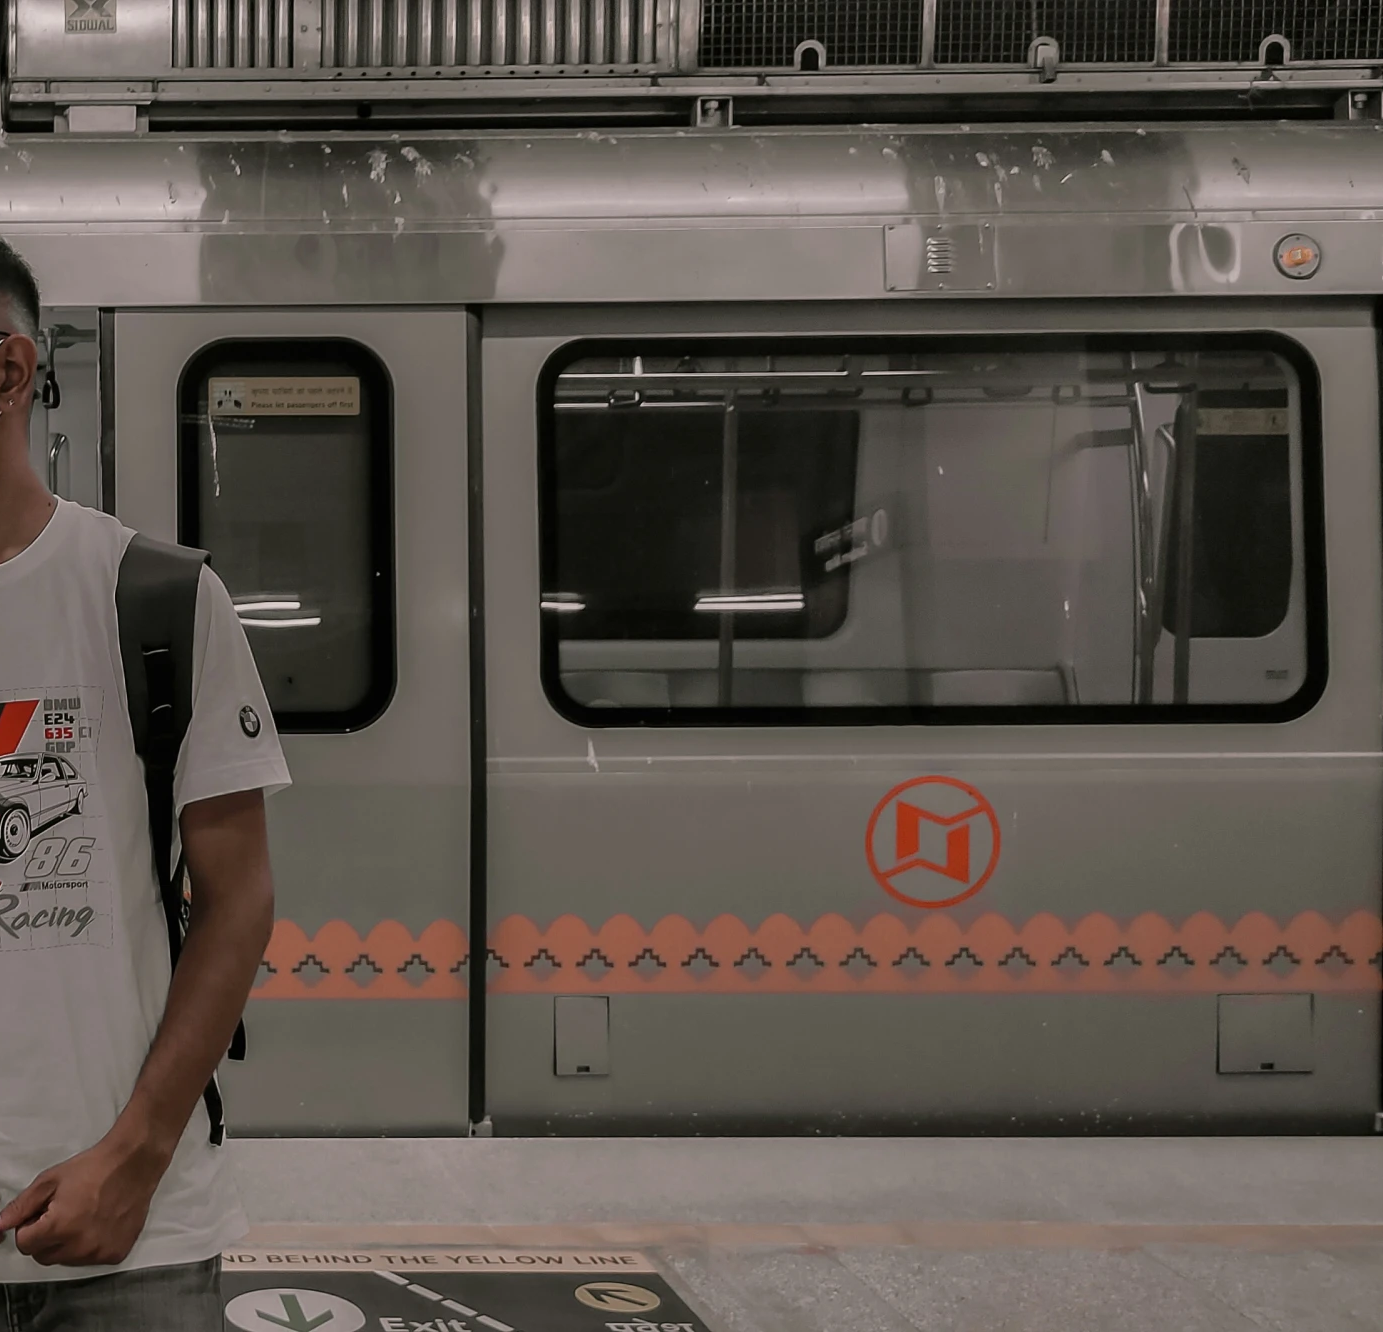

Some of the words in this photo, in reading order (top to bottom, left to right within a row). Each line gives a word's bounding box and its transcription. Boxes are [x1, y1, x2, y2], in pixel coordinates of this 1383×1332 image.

[67, 19, 115, 31] SIDWAL
[287, 402, 326, 410] passengers
[327, 401, 337, 409] off
[339, 401, 354, 409] first
[44, 698, 81, 711] BMW
[44, 713, 75, 725] E24
[45, 727, 74, 739] 635
[24, 836, 97, 879] 86
[41, 880, 89, 891] Motorsport
[266, 1254, 373, 1265] BEHIND
[380, 1254, 439, 1265] THE
[446, 1254, 564, 1265] YELLOW
[574, 1255, 638, 1266] LINE
[379, 1317, 472, 1332] Exit
